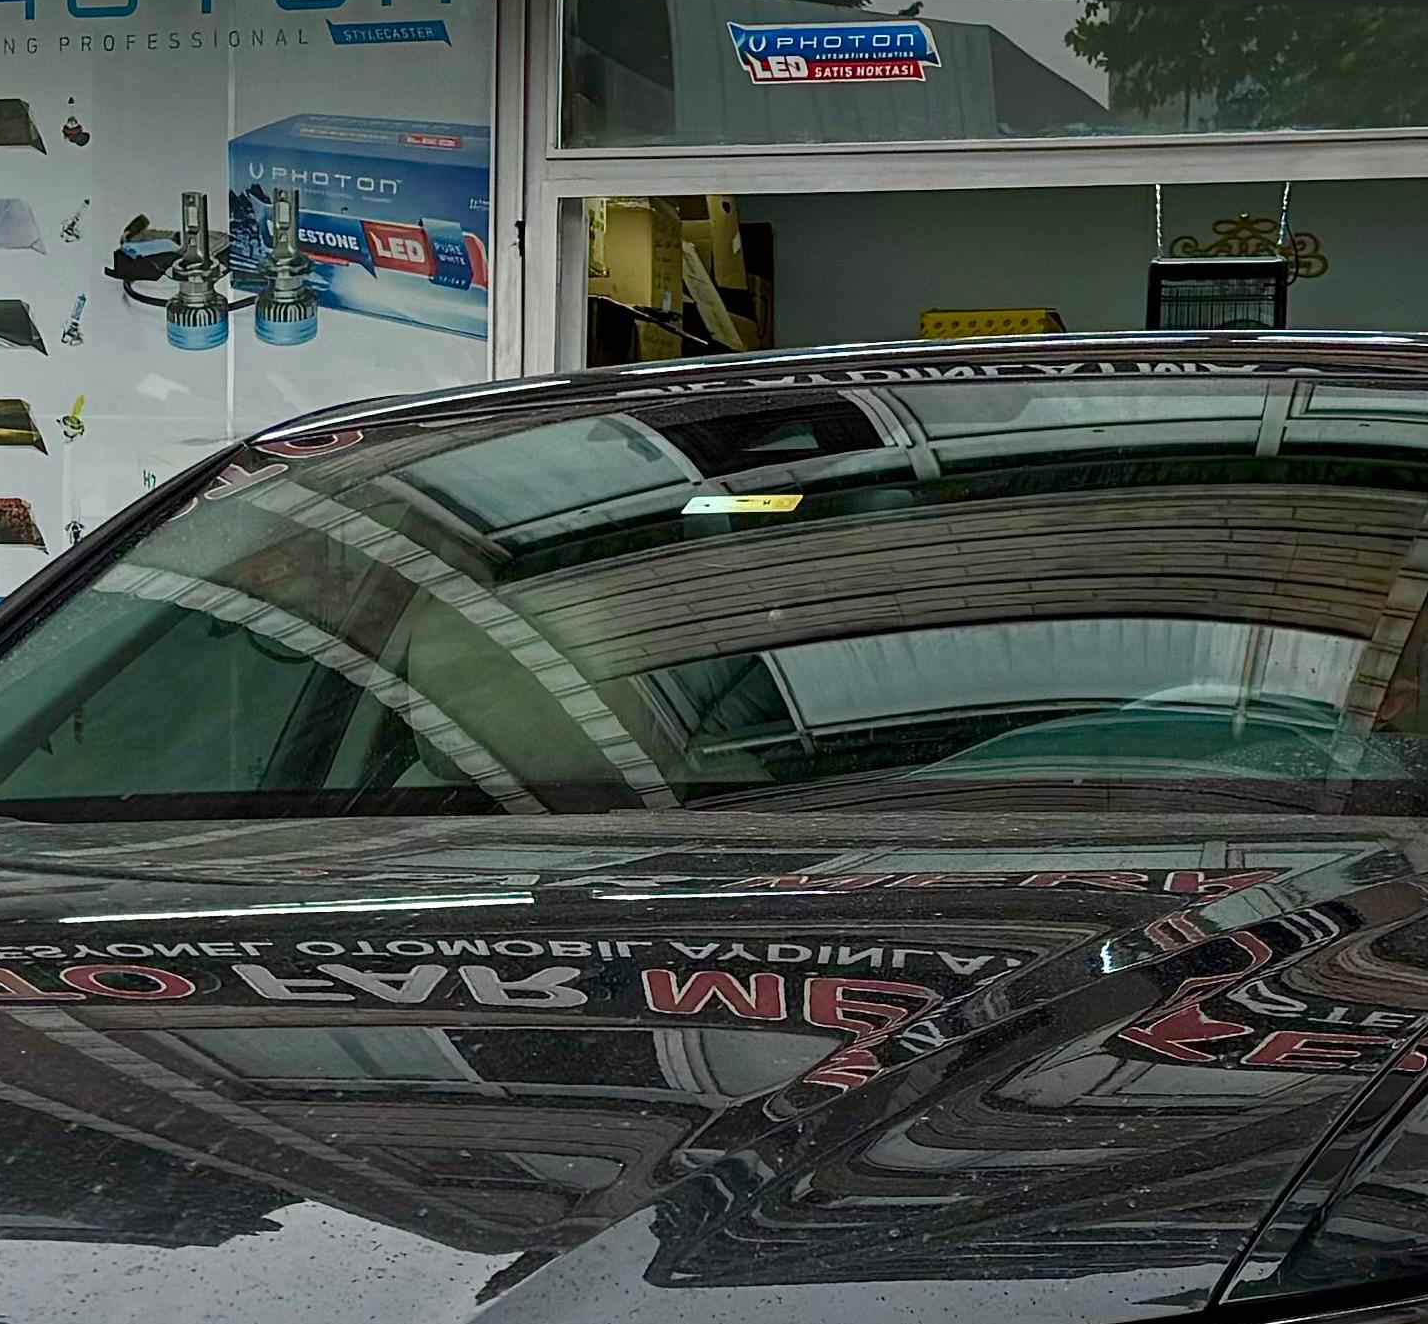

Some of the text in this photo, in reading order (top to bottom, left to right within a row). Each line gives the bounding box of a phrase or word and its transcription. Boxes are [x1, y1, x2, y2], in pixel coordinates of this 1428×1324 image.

[59, 28, 309, 53] PROFESSIONAL
[776, 33, 915, 50] PHOTON
[747, 54, 809, 79] LED
[856, 64, 914, 76] NOKTASI
[272, 166, 398, 196] PHOTON
[297, 227, 426, 263] ESTONE LED
